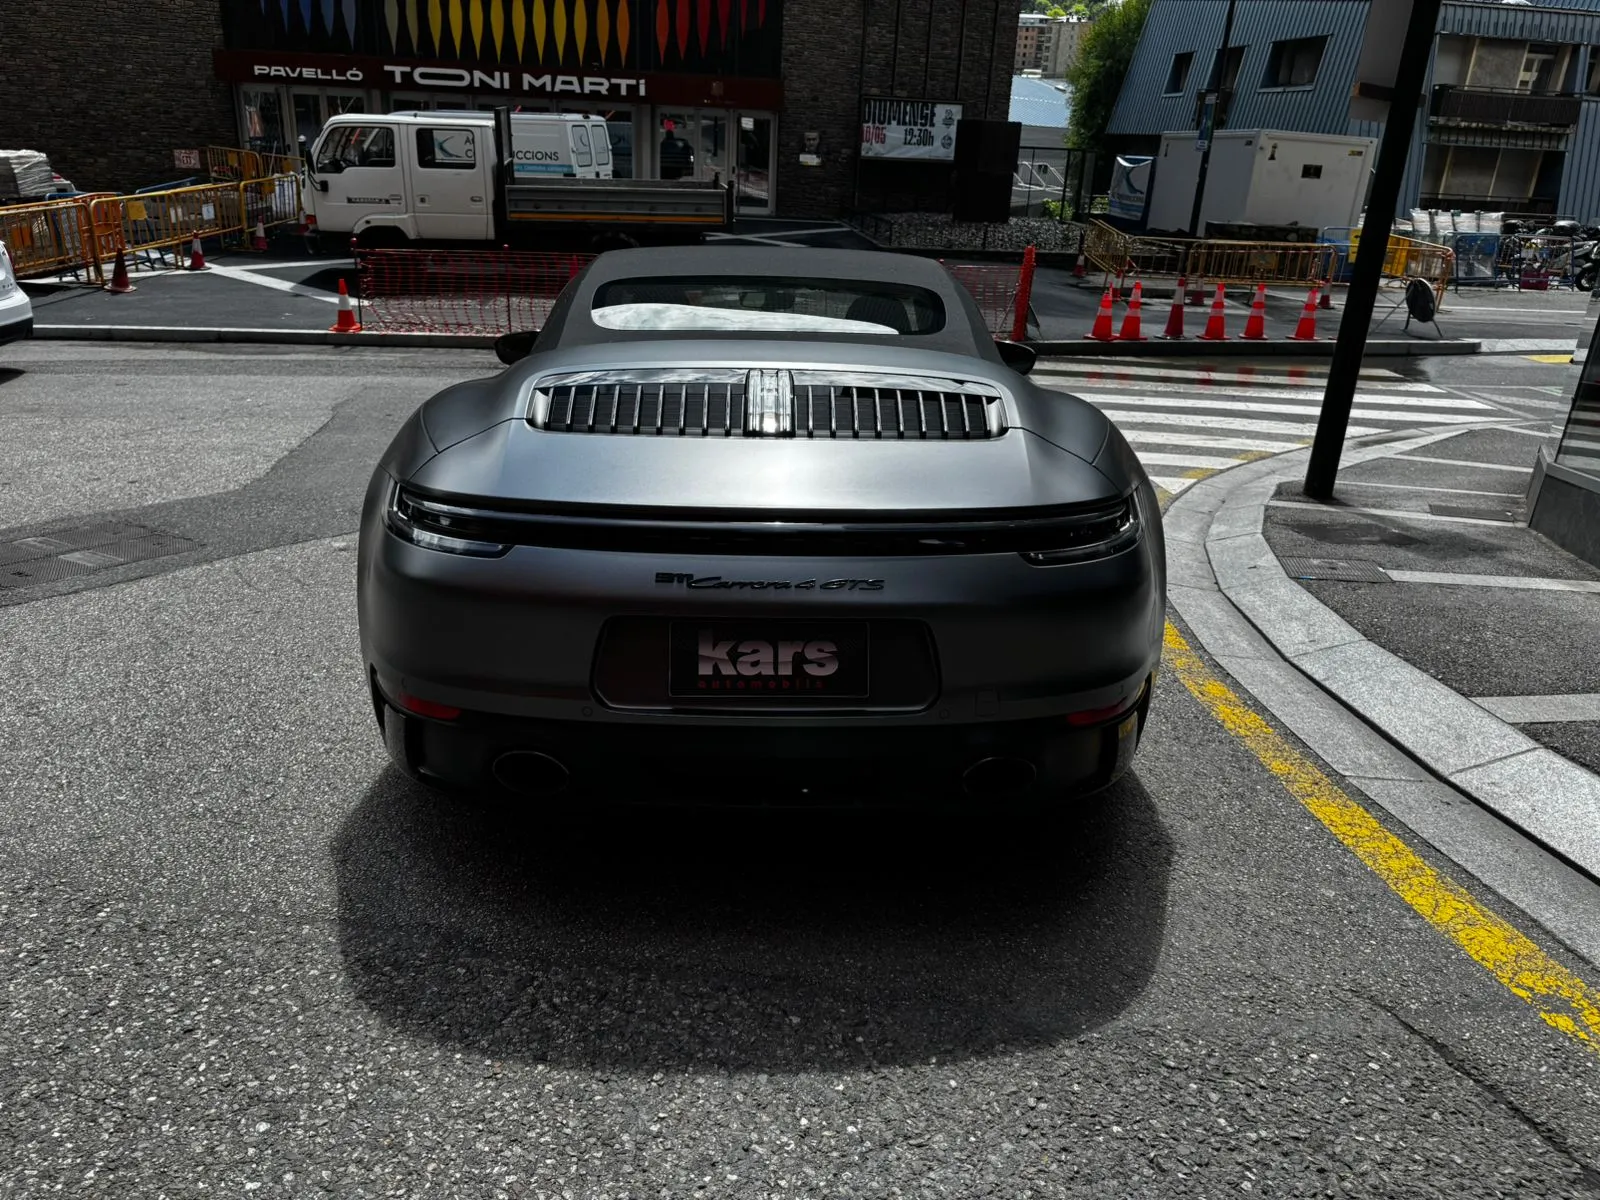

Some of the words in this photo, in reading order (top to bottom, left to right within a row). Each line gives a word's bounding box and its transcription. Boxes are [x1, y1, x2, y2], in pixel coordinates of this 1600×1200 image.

[253, 64, 364, 82] PAVELLÓ
[383, 64, 511, 90] TONI
[903, 128, 935, 147] 12:30h
[688, 576, 792, 590] Carrera
[795, 578, 816, 590] 4
[820, 578, 885, 591] GTS
[697, 628, 840, 677] kars
